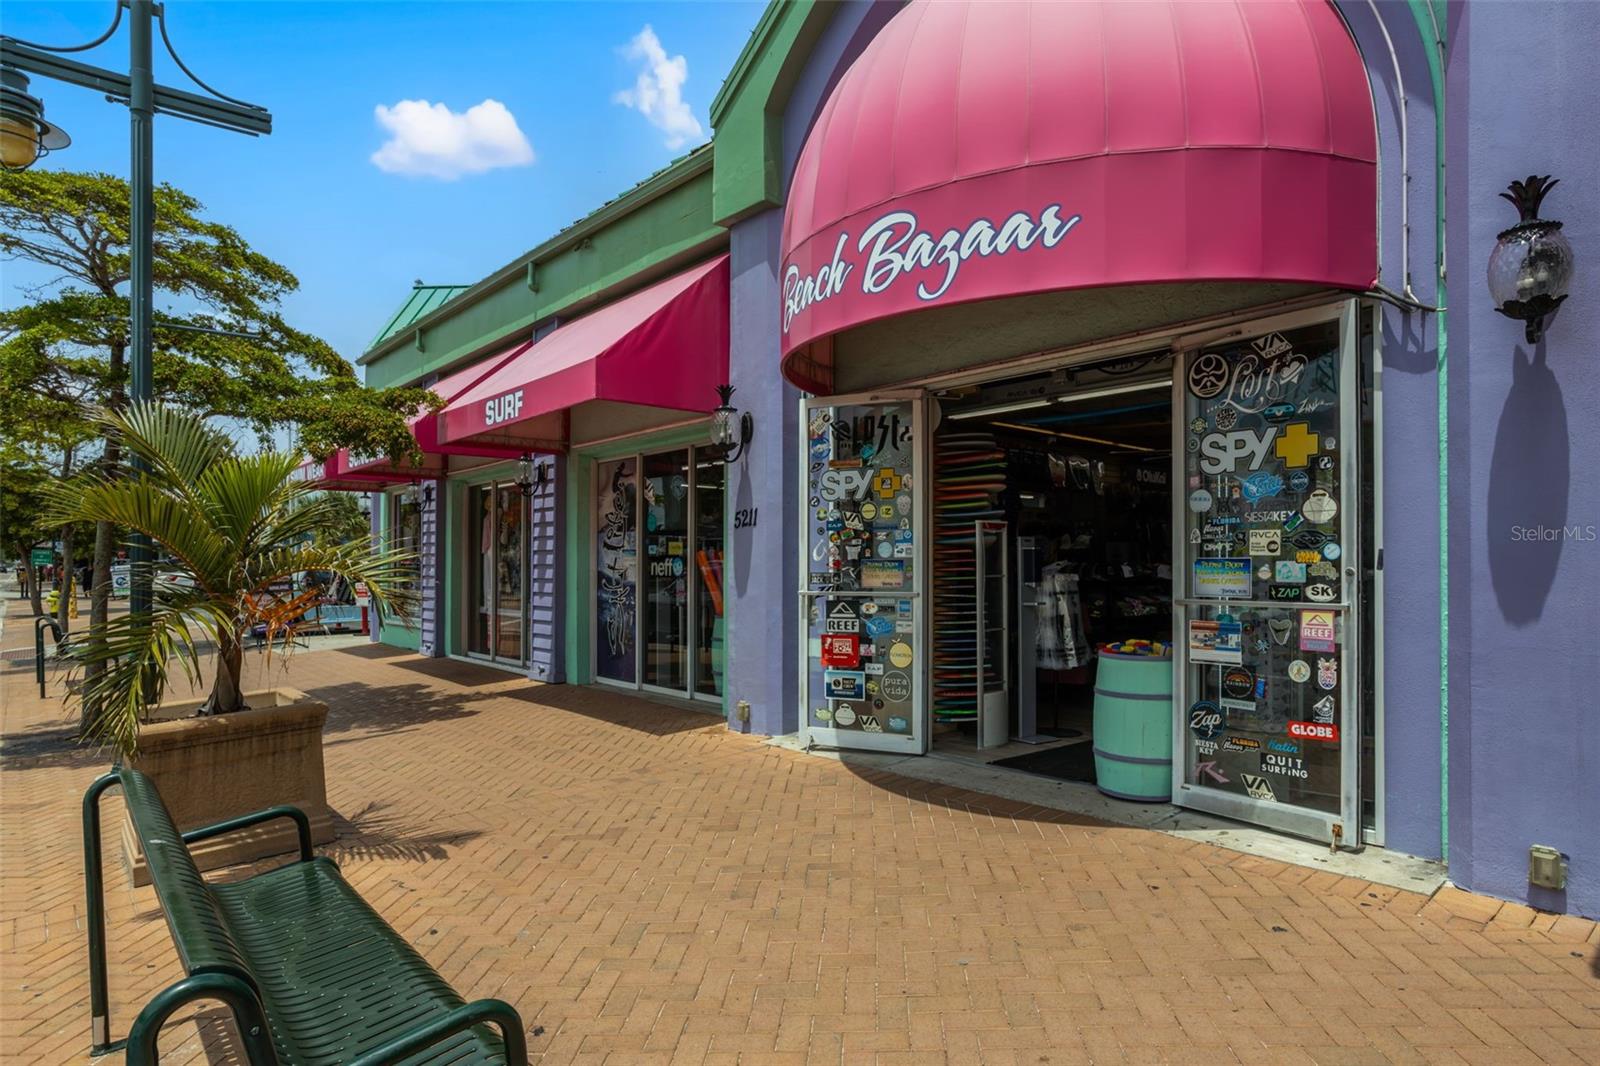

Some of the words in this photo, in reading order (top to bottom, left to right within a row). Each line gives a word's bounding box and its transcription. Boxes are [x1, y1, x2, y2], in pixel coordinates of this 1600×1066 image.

[782, 233, 853, 334] Beach
[857, 203, 1082, 300] Bazaar
[485, 389, 524, 426] SURF
[1200, 426, 1278, 475] SPY
[820, 469, 875, 501] SPY
[734, 507, 759, 529] 5211
[1250, 531, 1280, 539] RVCA
[650, 557, 673, 577] neff
[1277, 588, 1300, 598] ZAP
[1310, 586, 1331, 597] SK
[828, 620, 858, 631] REEF
[1303, 627, 1331, 638] REEF
[884, 677, 908, 687] pura
[885, 686, 907, 696] vida
[1190, 710, 1222, 730] Zap
[1291, 724, 1333, 738] GLOBE
[1194, 739, 1219, 750] SIESTA
[1199, 747, 1215, 756] KEY
[1266, 754, 1303, 769] QUIT
[1250, 790, 1278, 801] RVCA
